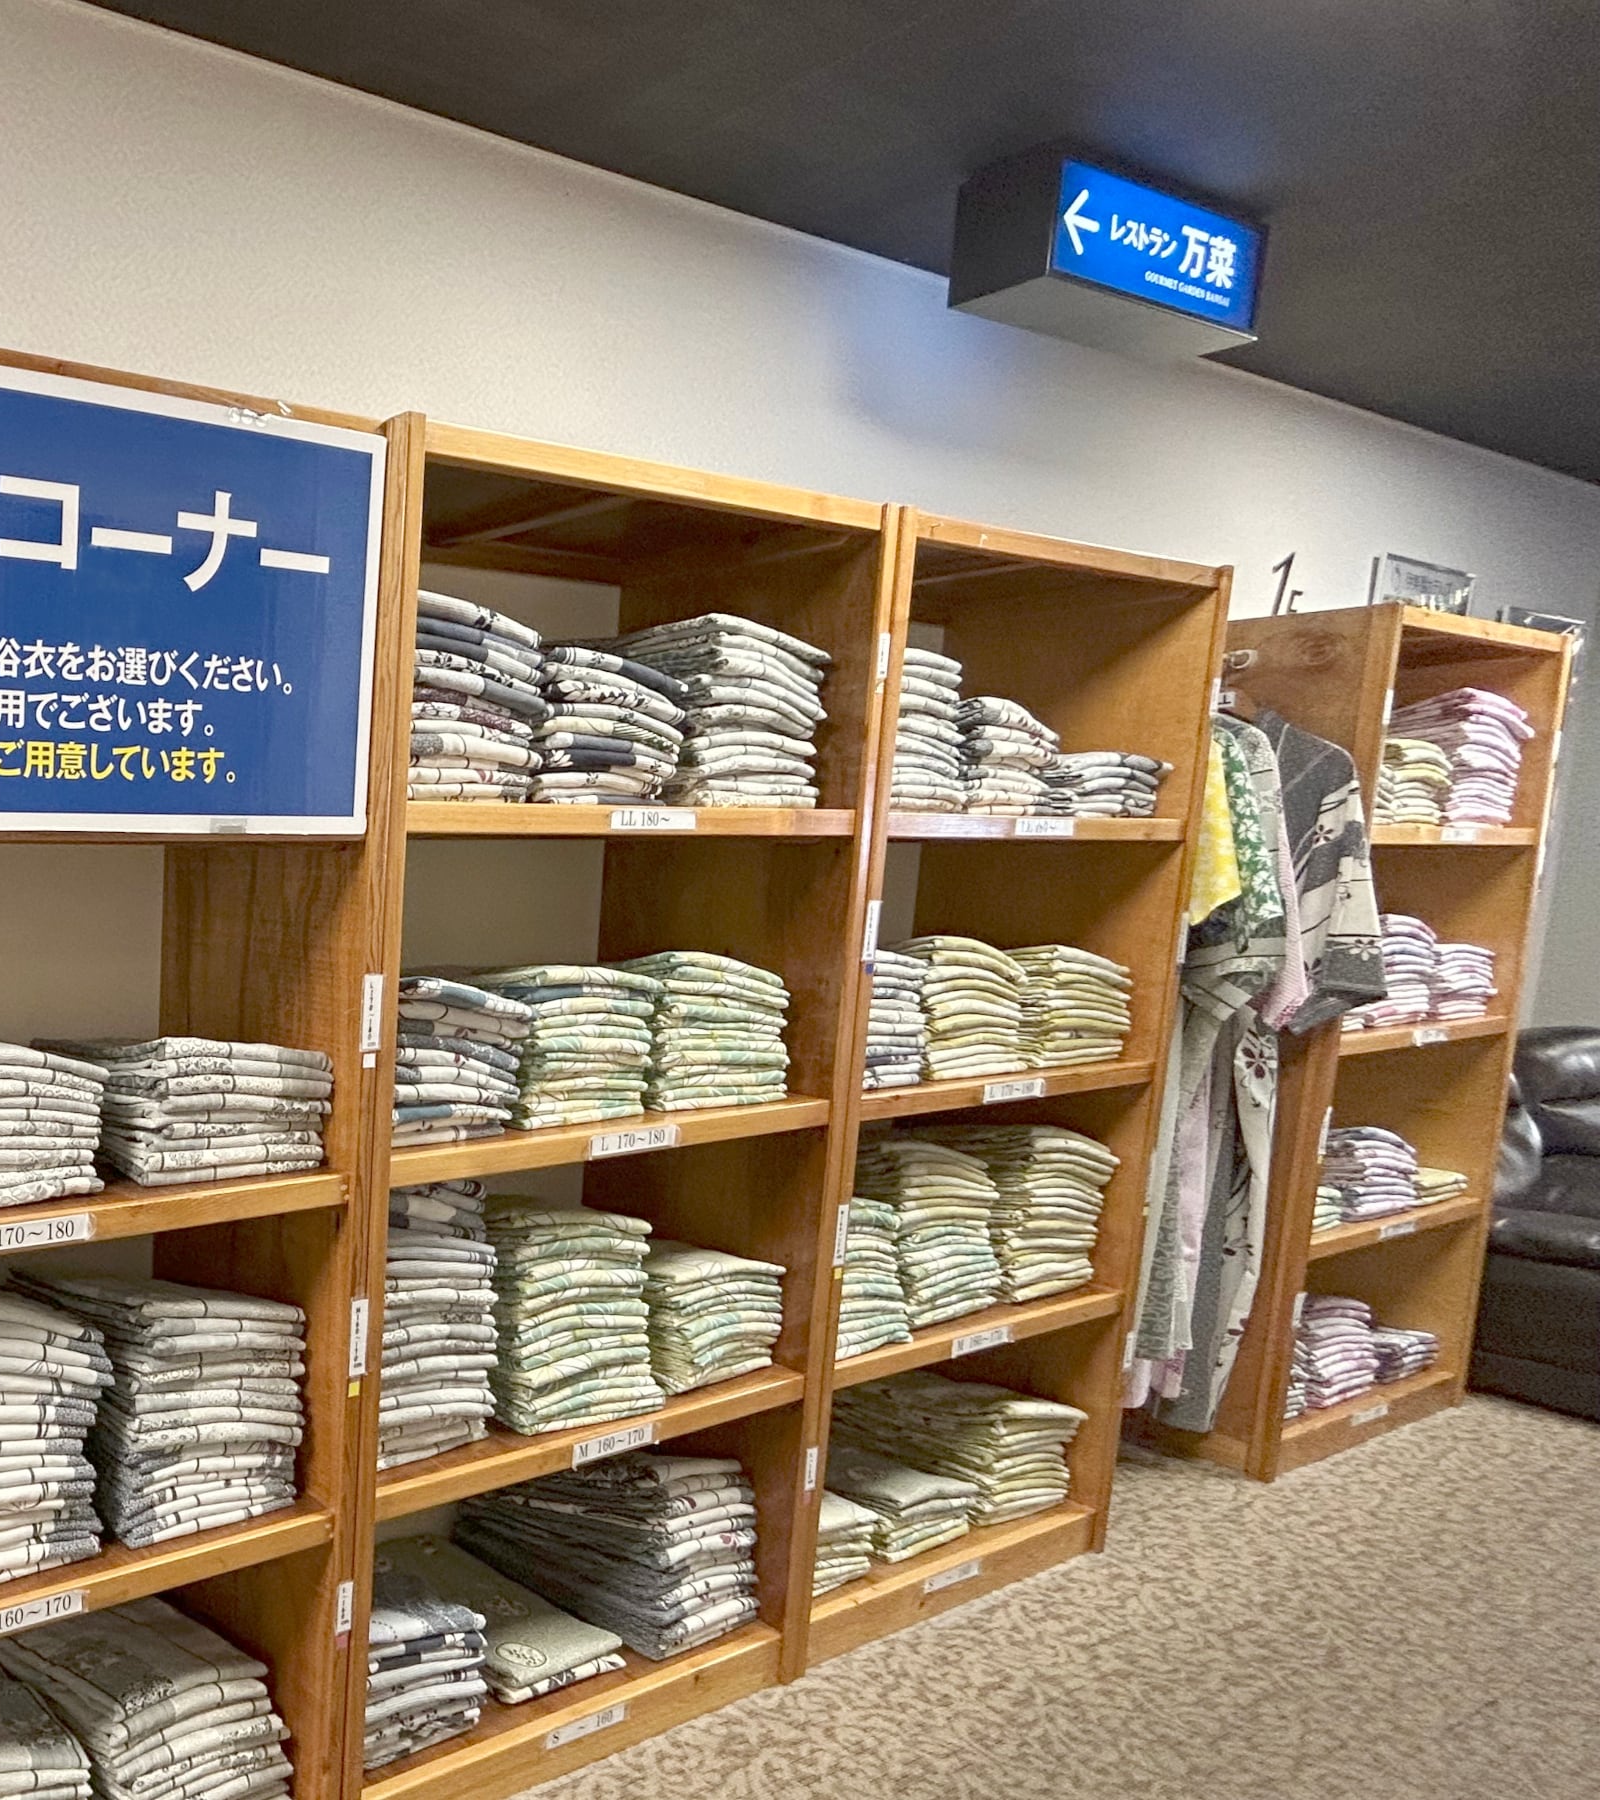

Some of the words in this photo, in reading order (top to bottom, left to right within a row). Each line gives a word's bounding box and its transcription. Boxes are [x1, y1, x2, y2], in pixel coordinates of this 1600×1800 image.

[1109, 213, 1178, 259] レストラン
[1178, 224, 1237, 289] 万菜
[620, 811, 636, 827] LL
[600, 1136, 609, 1152] L
[578, 1444, 588, 1458] M
